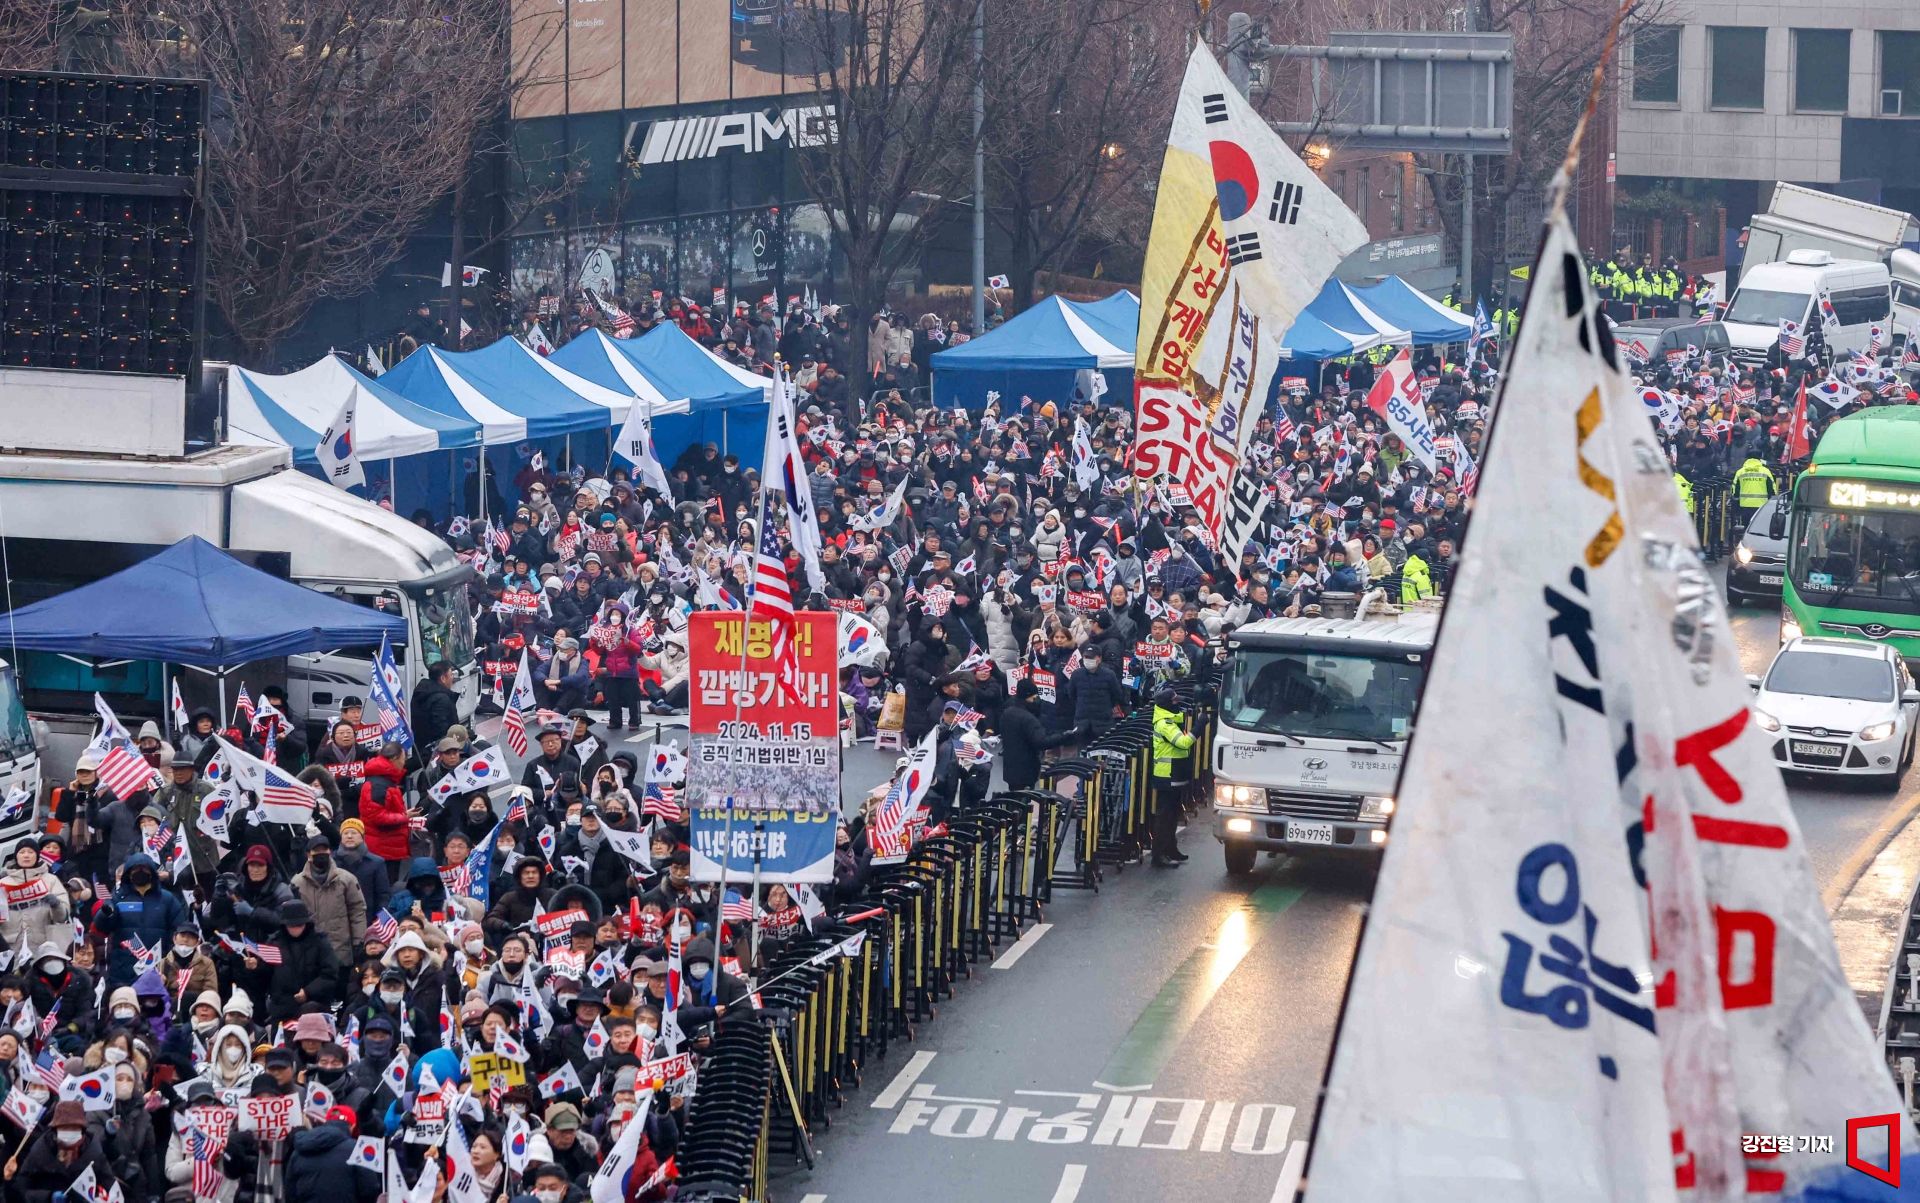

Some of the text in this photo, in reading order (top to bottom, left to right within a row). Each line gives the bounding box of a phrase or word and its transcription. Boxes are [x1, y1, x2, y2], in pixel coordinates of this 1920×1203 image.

[707, 105, 839, 158] AMG
[1220, 468, 1262, 563] THE
[504, 592, 537, 605] 부정선거
[830, 599, 863, 609] 부정선거
[1068, 593, 1098, 607] 부정선거
[594, 627, 617, 637] STOP
[1136, 643, 1171, 655] 부정선거
[805, 748, 826, 765] 1심
[1816, 746, 1838, 755] 6267
[328, 763, 364, 777] 부정선거
[474, 1057, 520, 1080] 구미
[637, 1055, 687, 1085] 부정선거
[247, 1098, 294, 1115] STOP
[253, 1114, 290, 1128] THE
[888, 1083, 1296, 1155] 이태원역
